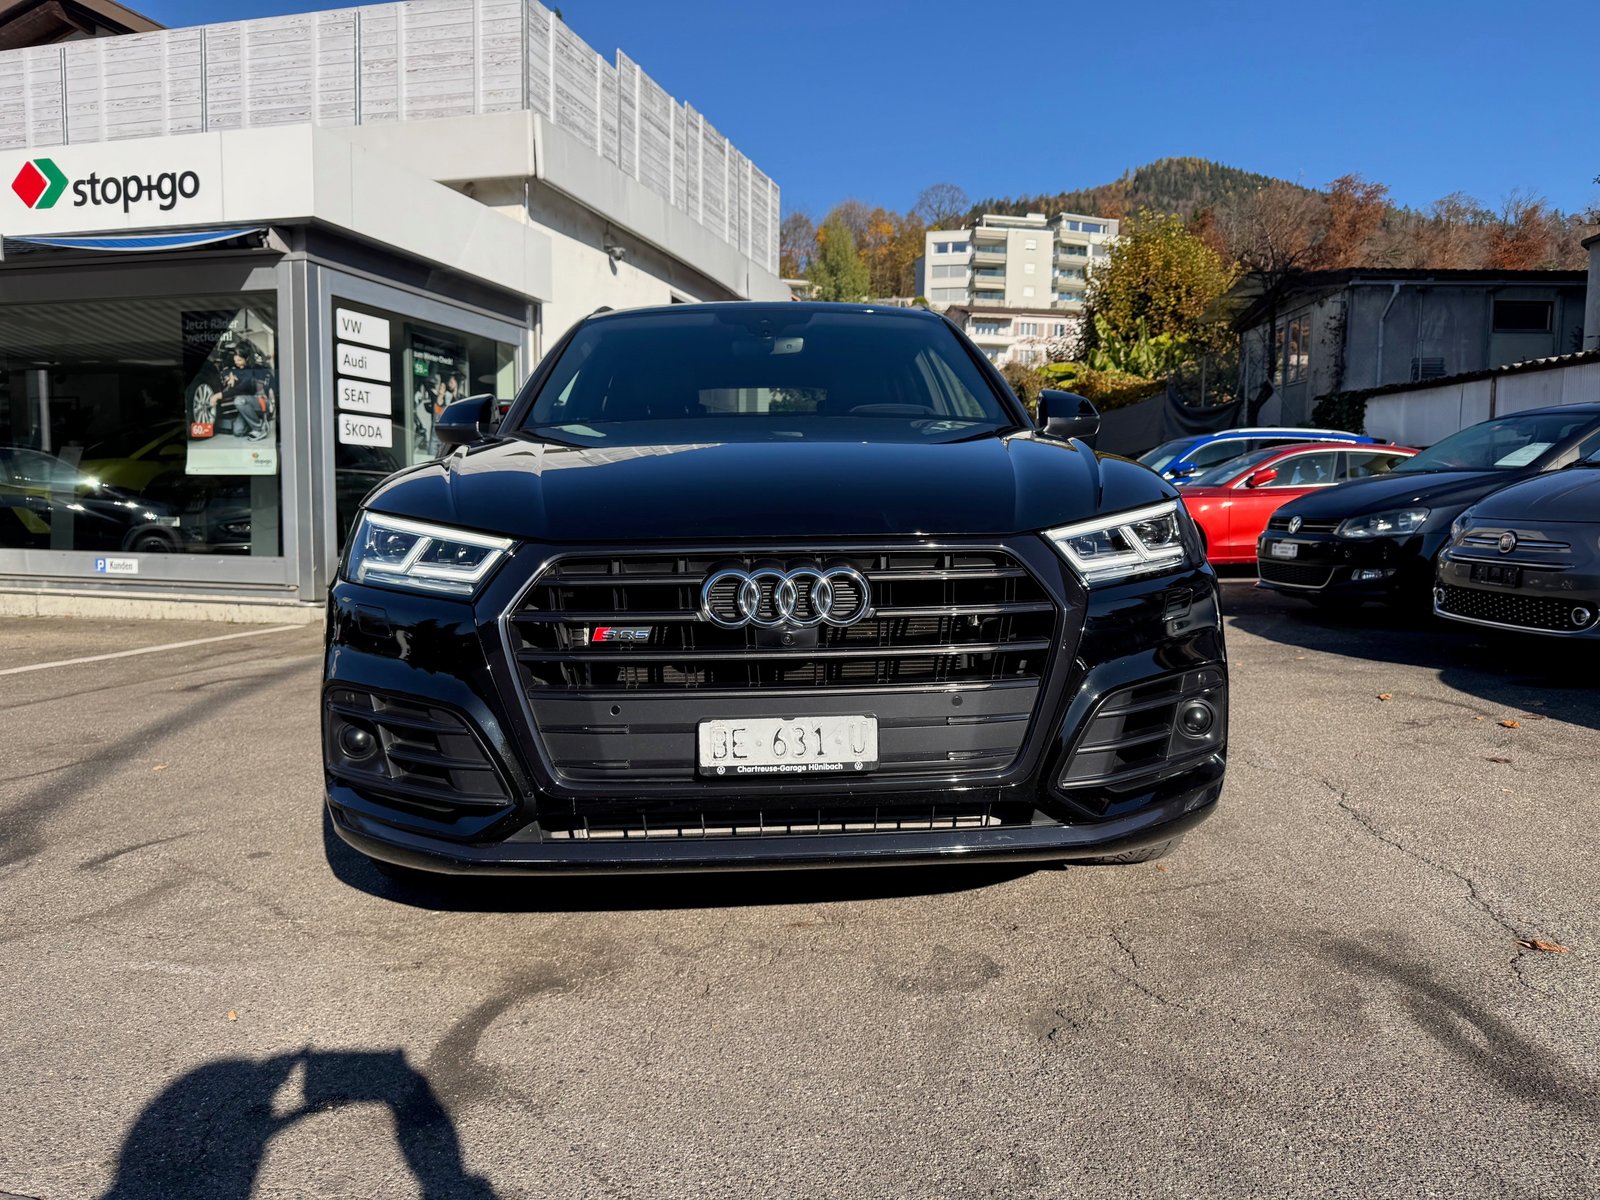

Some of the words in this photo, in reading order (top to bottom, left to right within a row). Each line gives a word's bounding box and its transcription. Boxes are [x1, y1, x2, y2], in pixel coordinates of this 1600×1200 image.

[72, 171, 200, 213] stop+go
[342, 317, 362, 334] VW
[343, 354, 367, 369] Audi
[344, 388, 370, 404] SEAT
[345, 420, 382, 439] ŠKODA
[110, 561, 132, 570] Kunden
[772, 725, 825, 757] 631
[737, 764, 807, 774] Chartreuse-Garage
[808, 763, 843, 771] Hünibach
